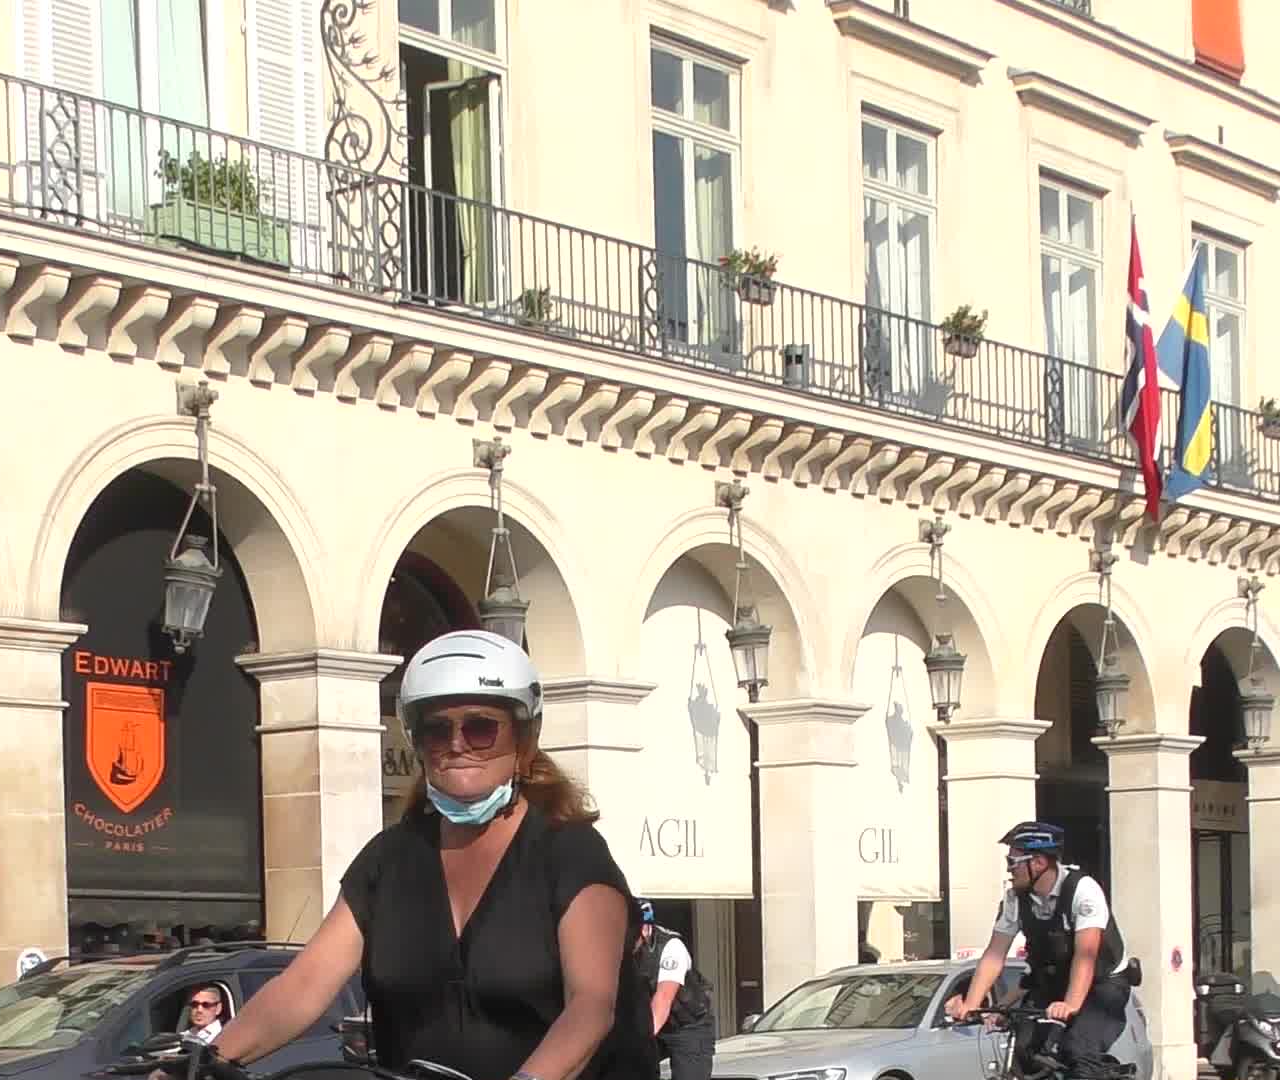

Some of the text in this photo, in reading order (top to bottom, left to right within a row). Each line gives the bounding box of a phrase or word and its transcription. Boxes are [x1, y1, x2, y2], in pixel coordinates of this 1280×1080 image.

[75, 651, 172, 681] EDWART
[73, 802, 174, 838] CHOCOLATIER
[105, 841, 145, 852] PARIS
